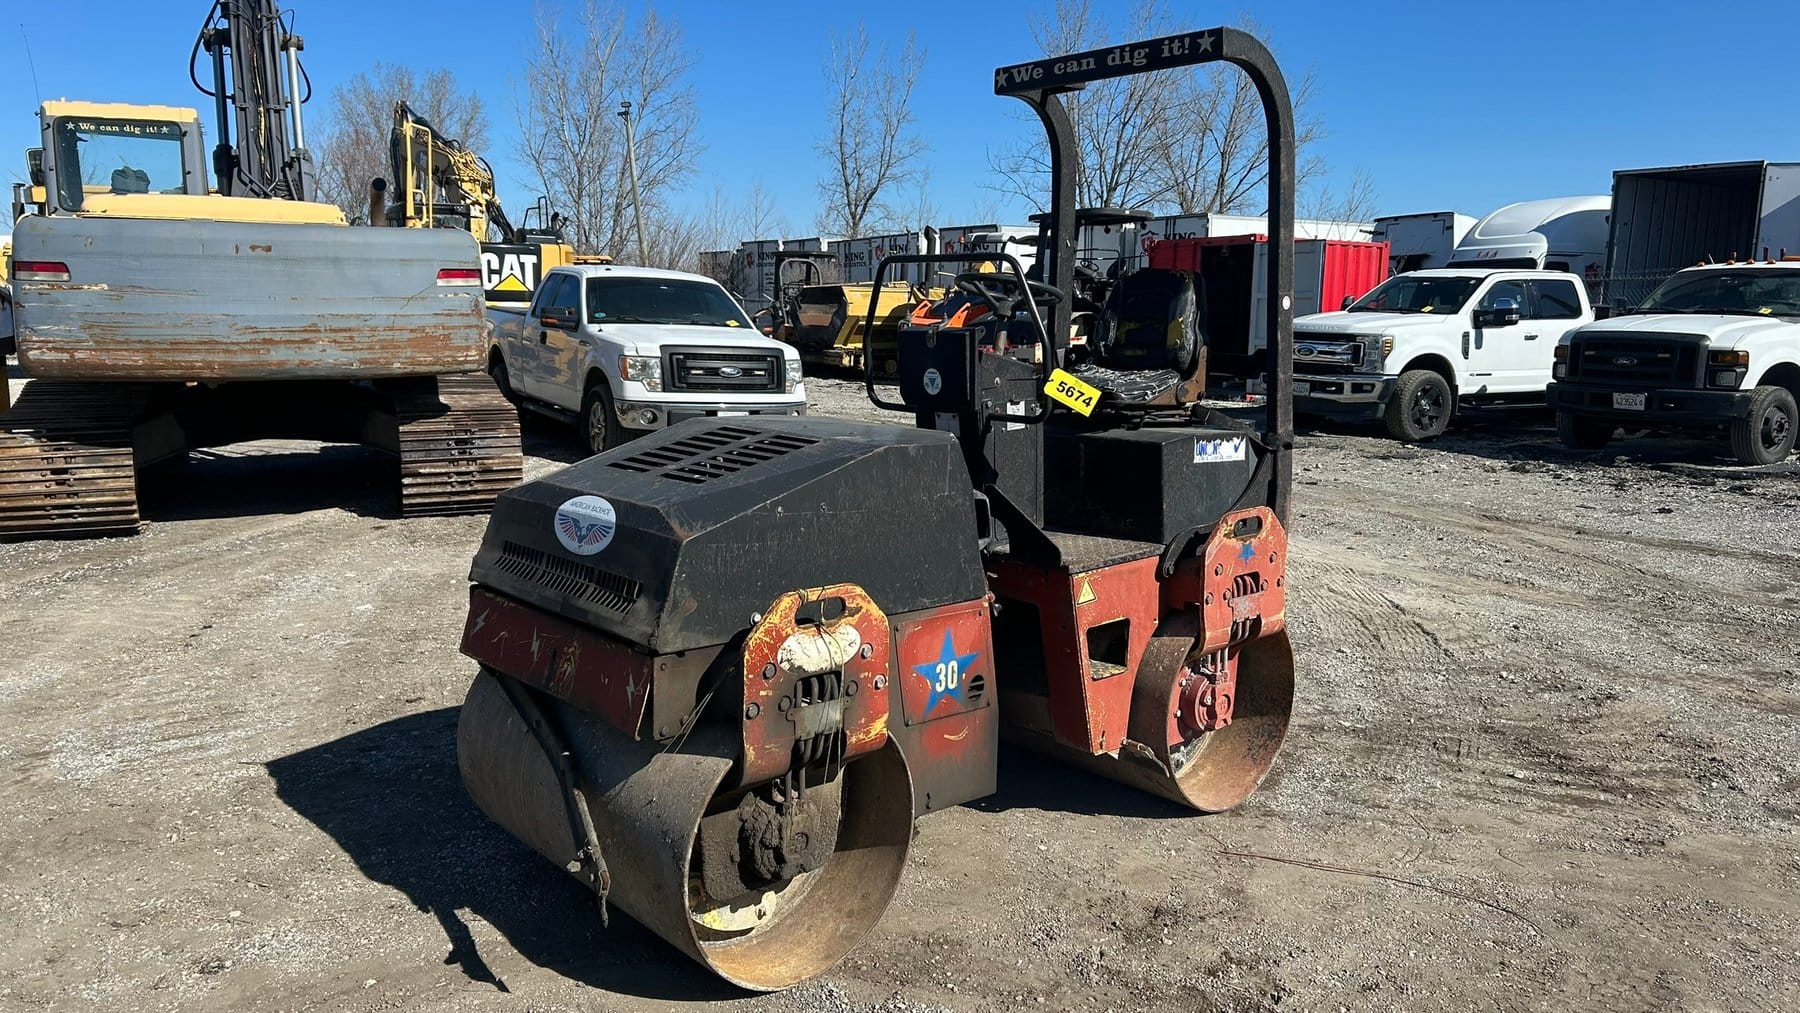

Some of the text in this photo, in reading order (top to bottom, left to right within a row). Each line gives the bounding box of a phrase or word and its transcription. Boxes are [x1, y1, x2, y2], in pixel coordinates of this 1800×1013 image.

[1012, 37, 1190, 83] We can dig it!
[79, 122, 96, 131] We
[99, 124, 119, 132] can
[123, 124, 141, 134] dig
[844, 251, 865, 262] KING
[480, 252, 538, 291] CAT
[1056, 381, 1093, 407] 5674
[935, 660, 958, 692] 30
